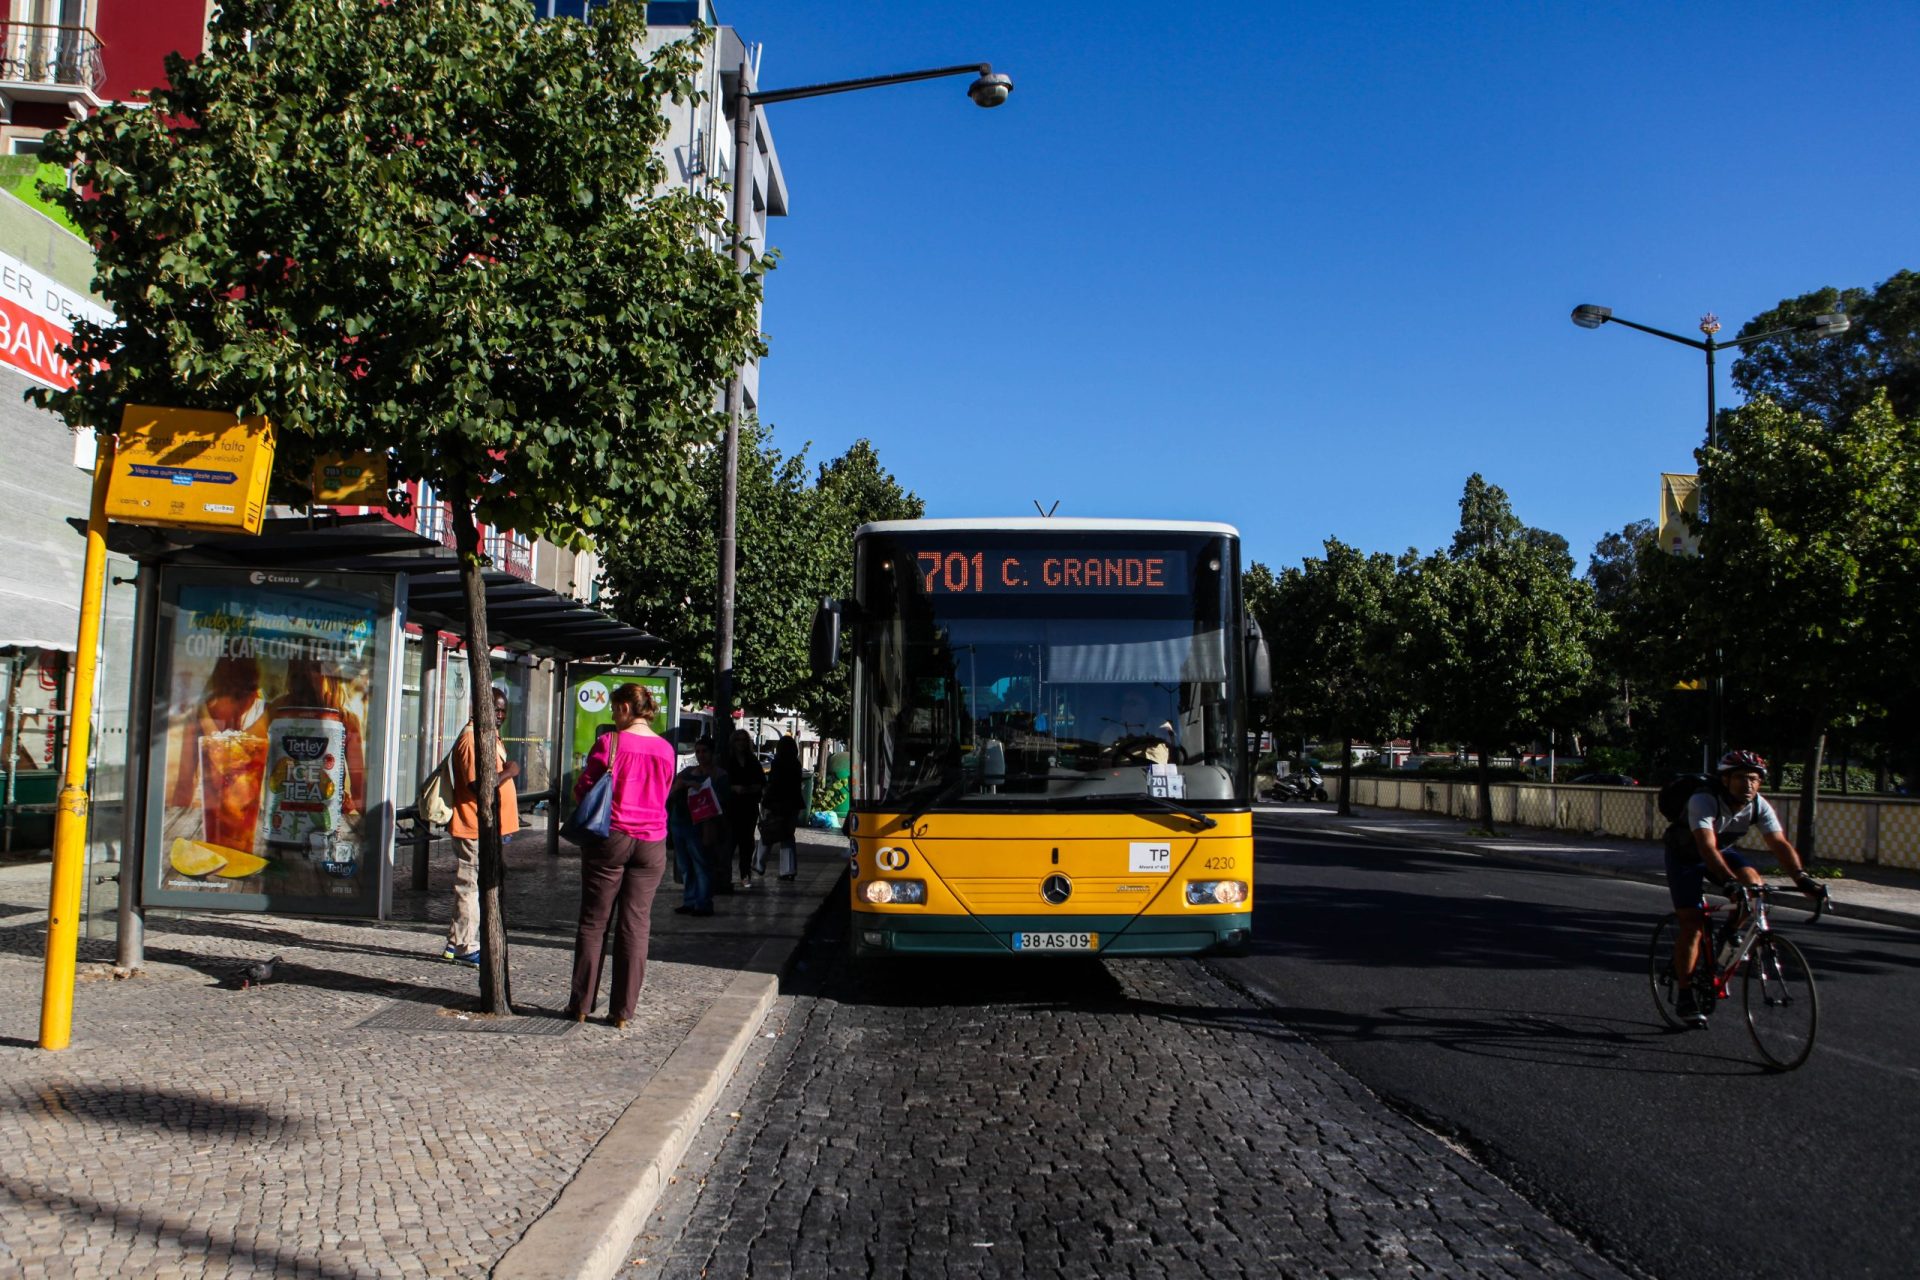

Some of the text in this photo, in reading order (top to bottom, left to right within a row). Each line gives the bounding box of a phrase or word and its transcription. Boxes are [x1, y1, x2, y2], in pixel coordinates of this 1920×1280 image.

[46, 290, 73, 319] DE
[221, 439, 246, 452] falta
[918, 552, 1165, 592] 701 C. GRANDE
[185, 634, 367, 662] COMEÇAM COM TETLEY
[579, 689, 606, 704] OLX
[286, 738, 325, 756] Tetley
[287, 764, 321, 783] ICE
[1152, 777, 1167, 786] 701
[282, 782, 323, 801] TEA
[1157, 788, 1163, 797] 2
[1149, 849, 1169, 862] TP
[326, 863, 352, 876] Tetley
[1204, 857, 1236, 870] 4230
